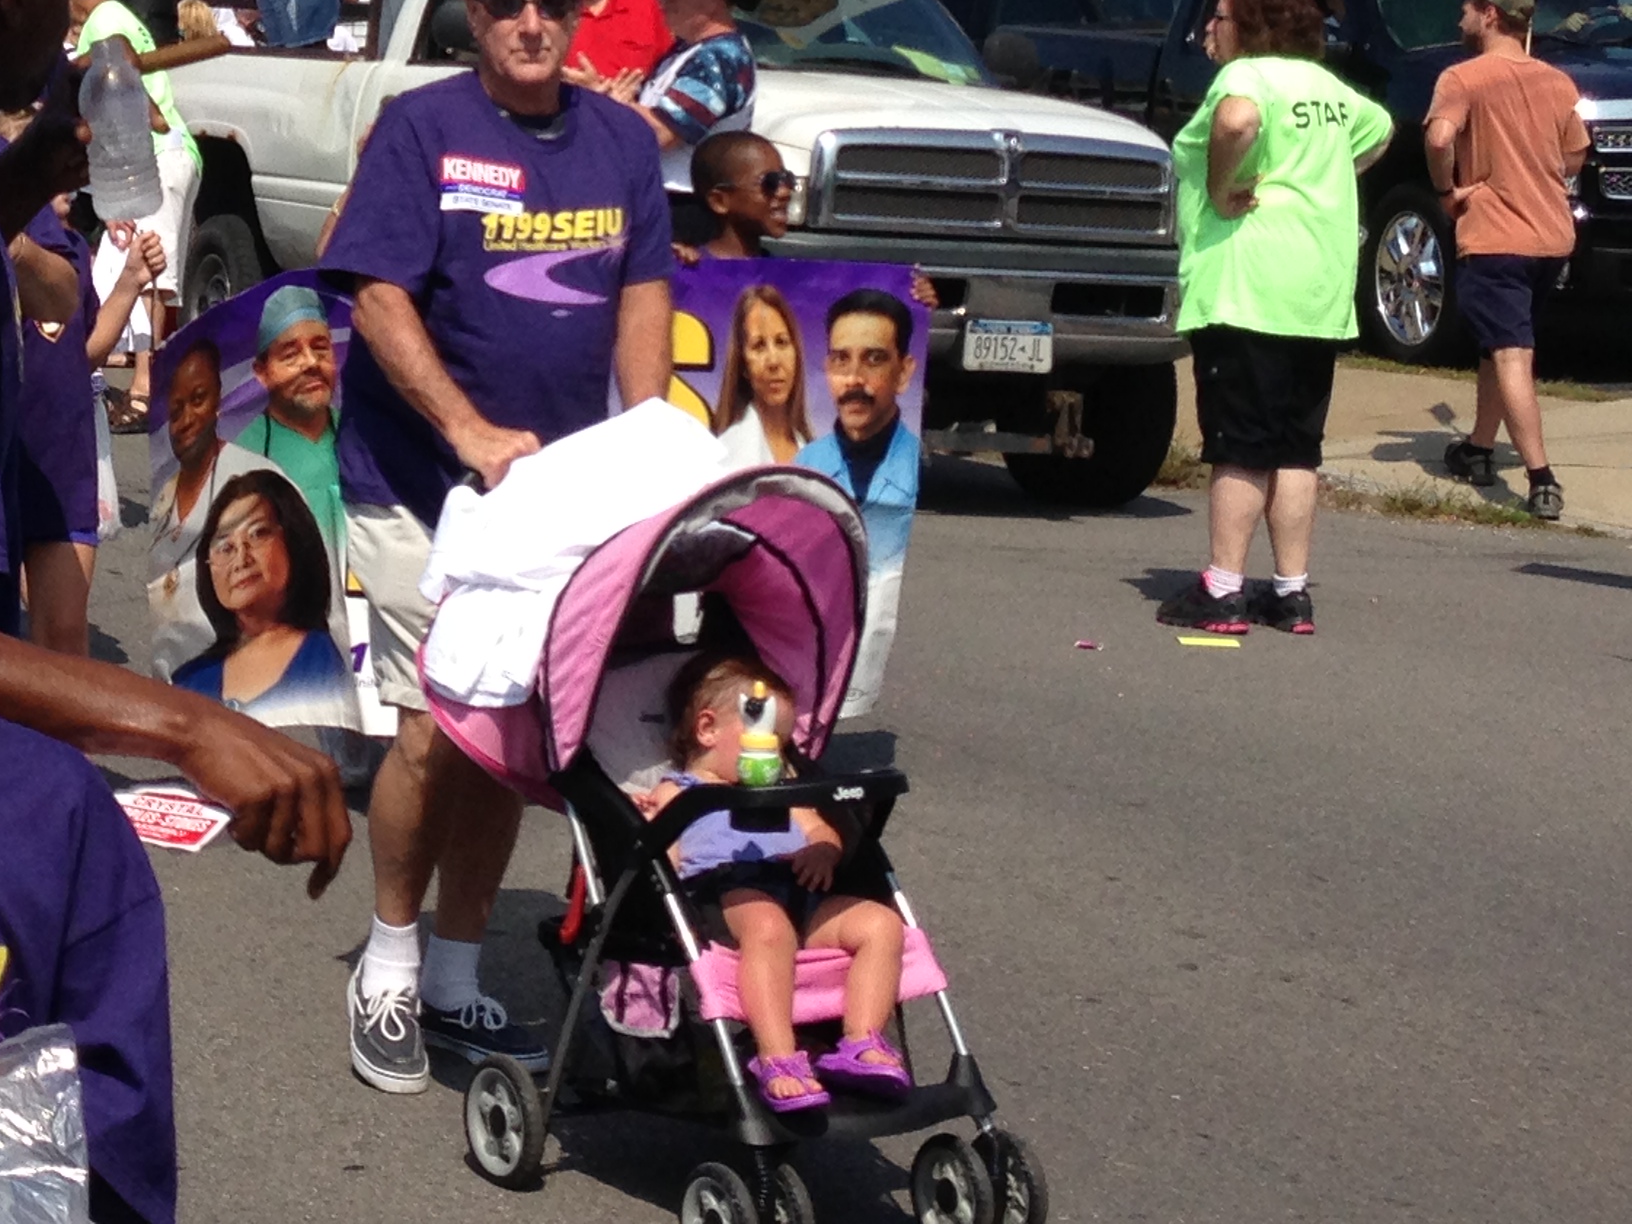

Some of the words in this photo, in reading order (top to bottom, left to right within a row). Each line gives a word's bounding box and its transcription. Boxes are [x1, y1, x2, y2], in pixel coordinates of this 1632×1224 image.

[442, 157, 521, 191] KENNEDY
[481, 207, 624, 242] 1199SEIU
[832, 786, 865, 801] Jeep
